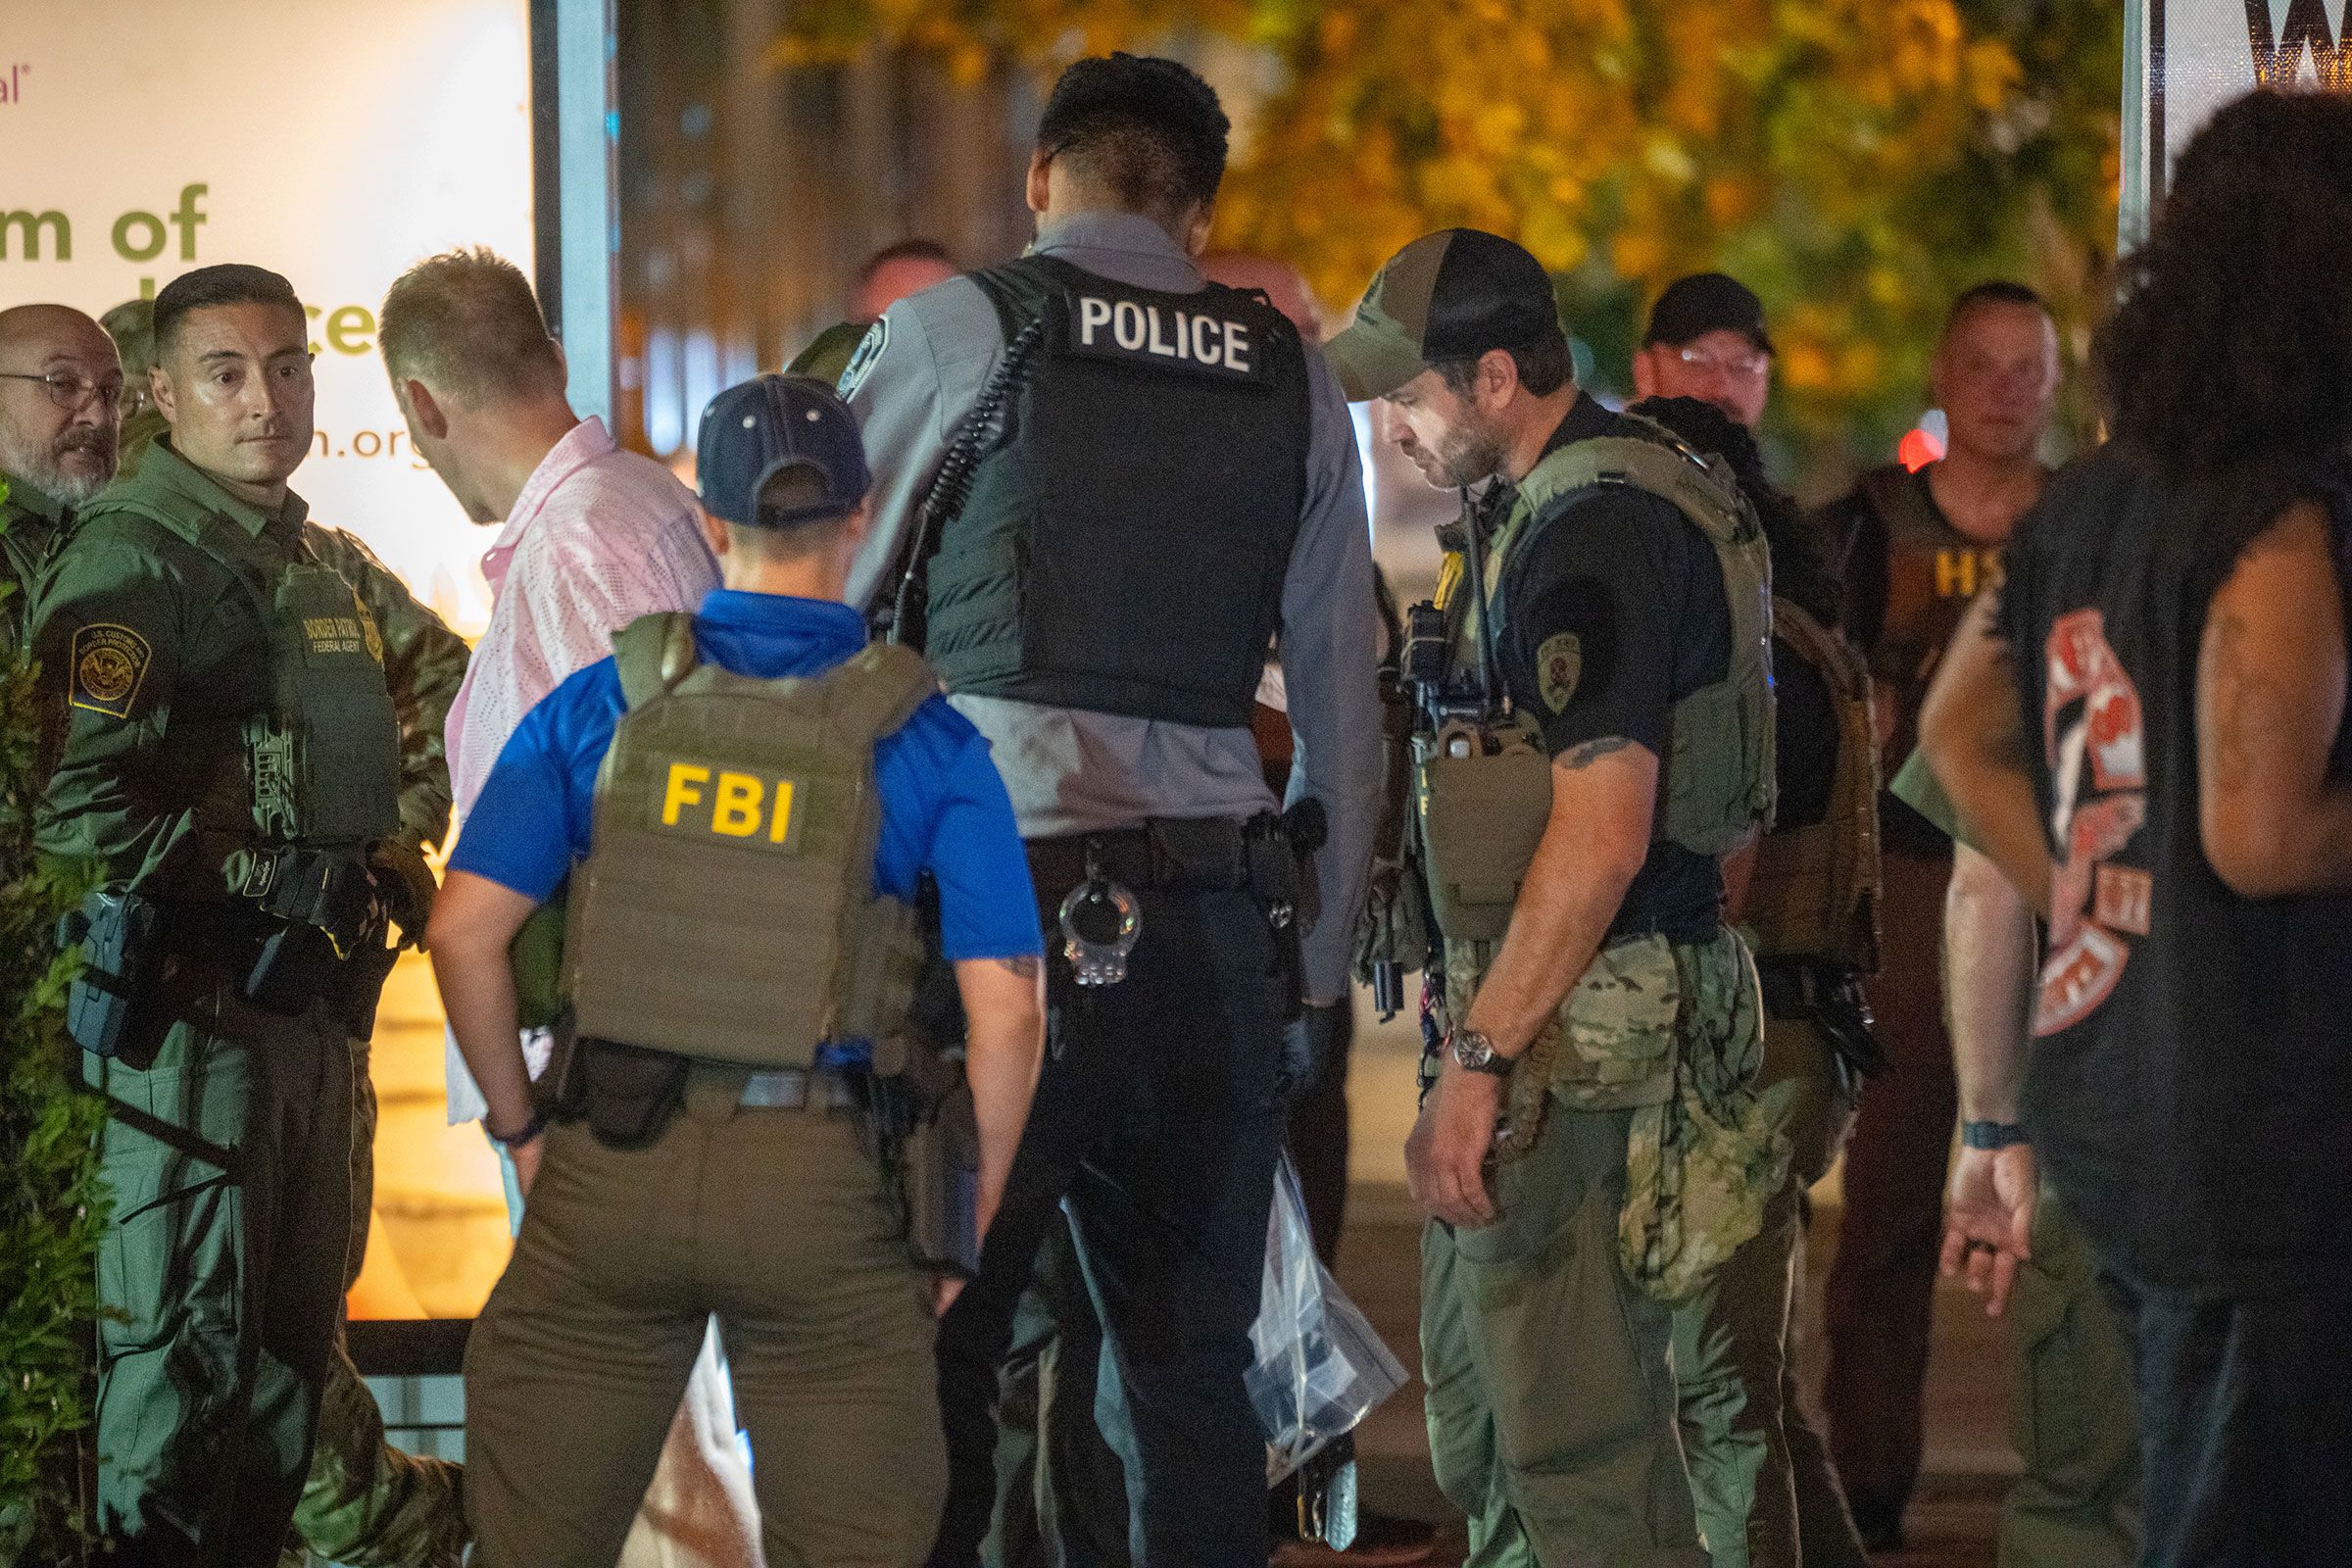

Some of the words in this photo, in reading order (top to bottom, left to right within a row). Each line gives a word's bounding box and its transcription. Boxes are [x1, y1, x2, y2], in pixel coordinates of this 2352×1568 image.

[112, 183, 208, 262] of
[1080, 296, 1250, 372] POLICE
[662, 763, 795, 843] FBI
